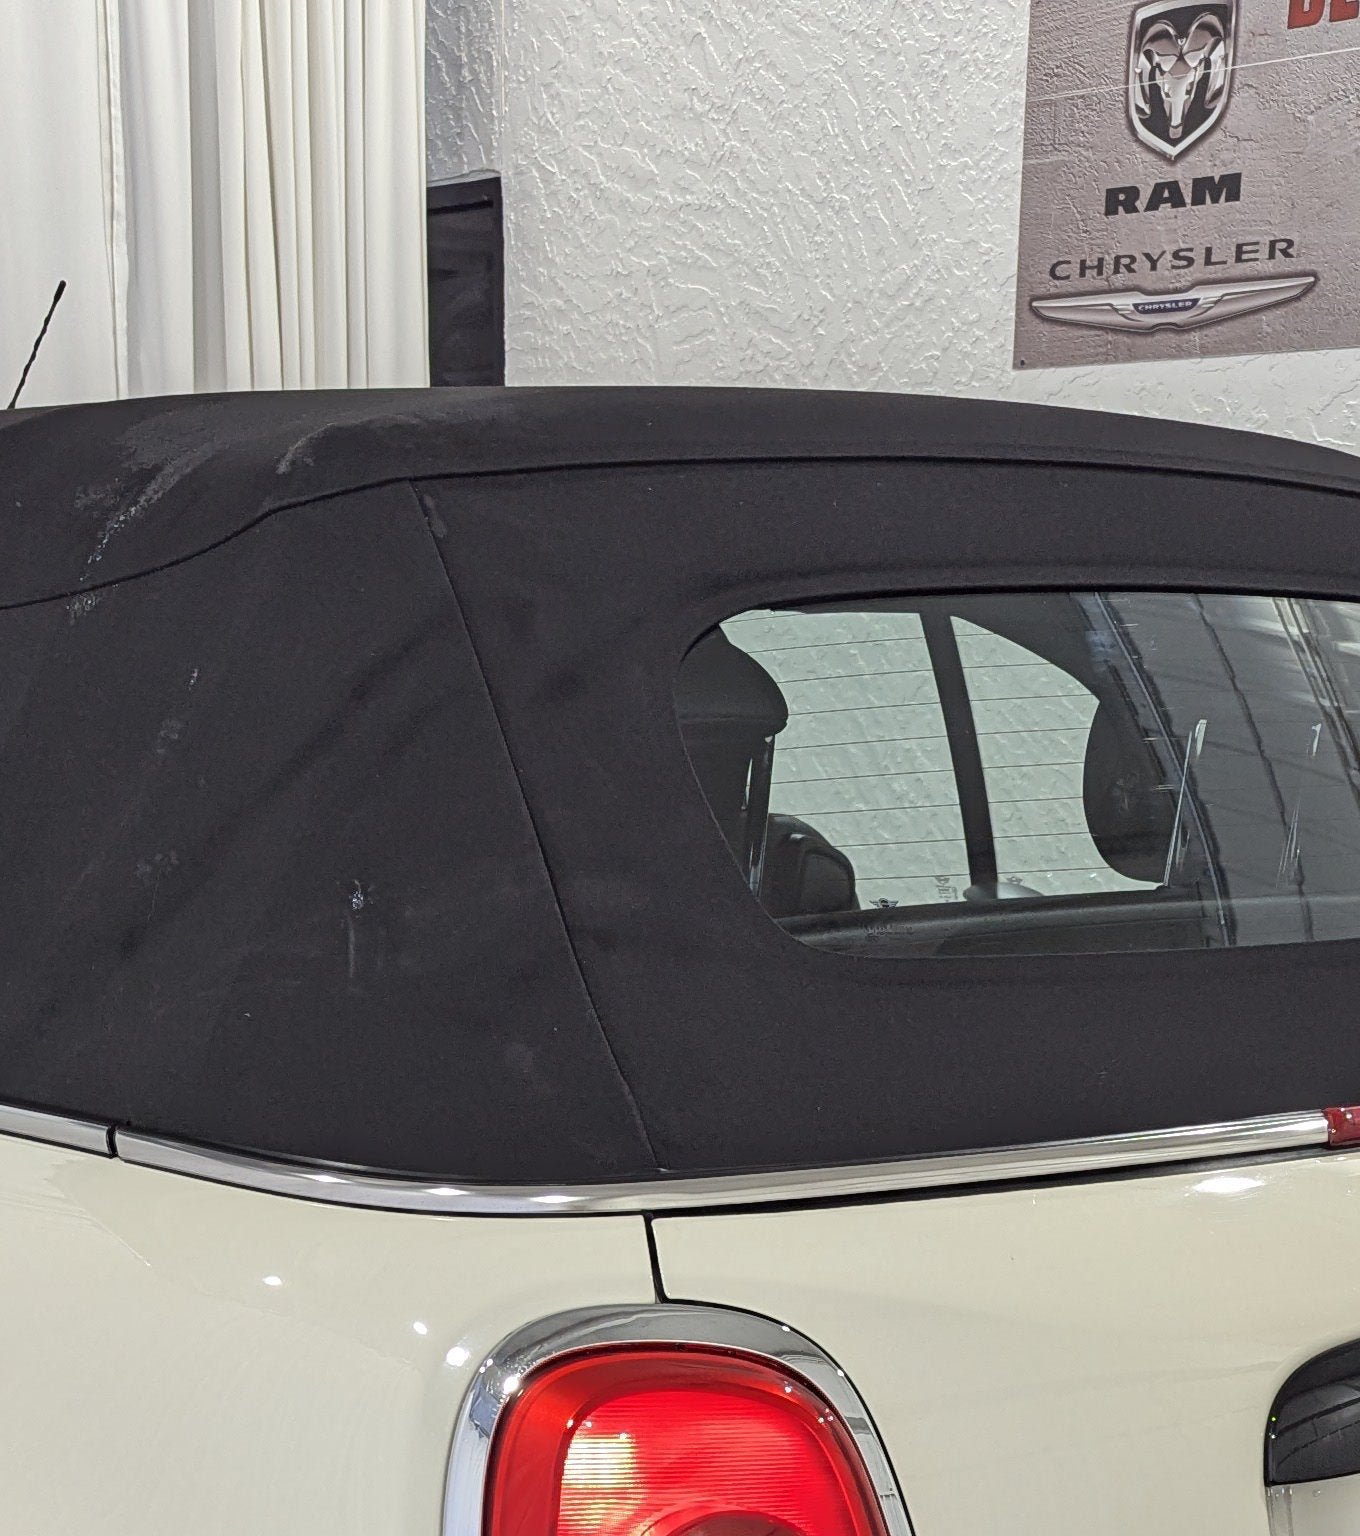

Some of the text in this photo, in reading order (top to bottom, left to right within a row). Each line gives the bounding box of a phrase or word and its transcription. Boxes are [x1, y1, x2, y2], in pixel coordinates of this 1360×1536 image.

[1104, 172, 1243, 216] RAM
[1050, 238, 1295, 281] CHRYSLER
[1137, 300, 1193, 311] CHRYSLER
